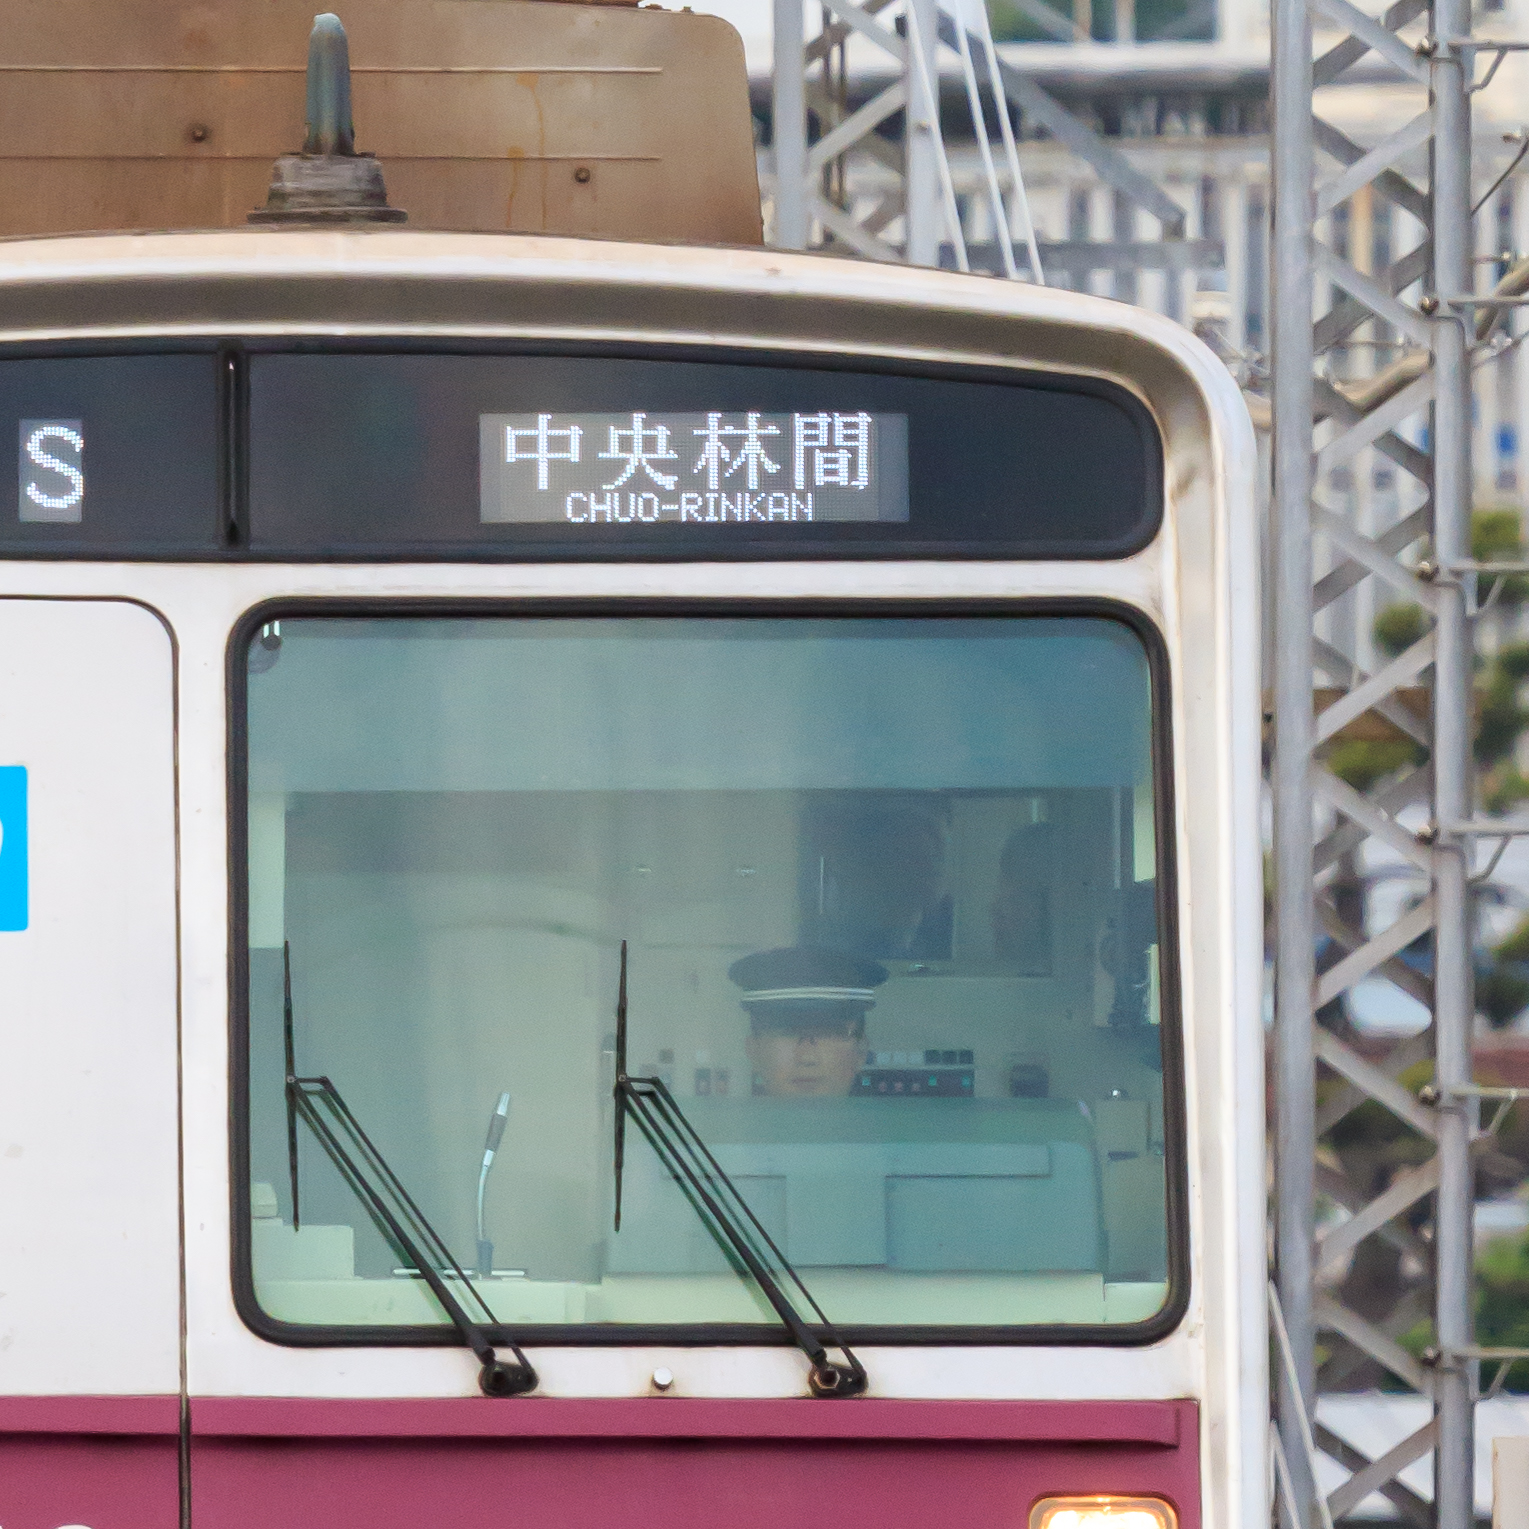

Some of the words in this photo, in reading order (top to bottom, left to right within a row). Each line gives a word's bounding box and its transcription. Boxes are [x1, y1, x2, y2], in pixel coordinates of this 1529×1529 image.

[504, 412, 872, 491] 中央林間
[565, 491, 814, 523] CHUO-RINKAN
